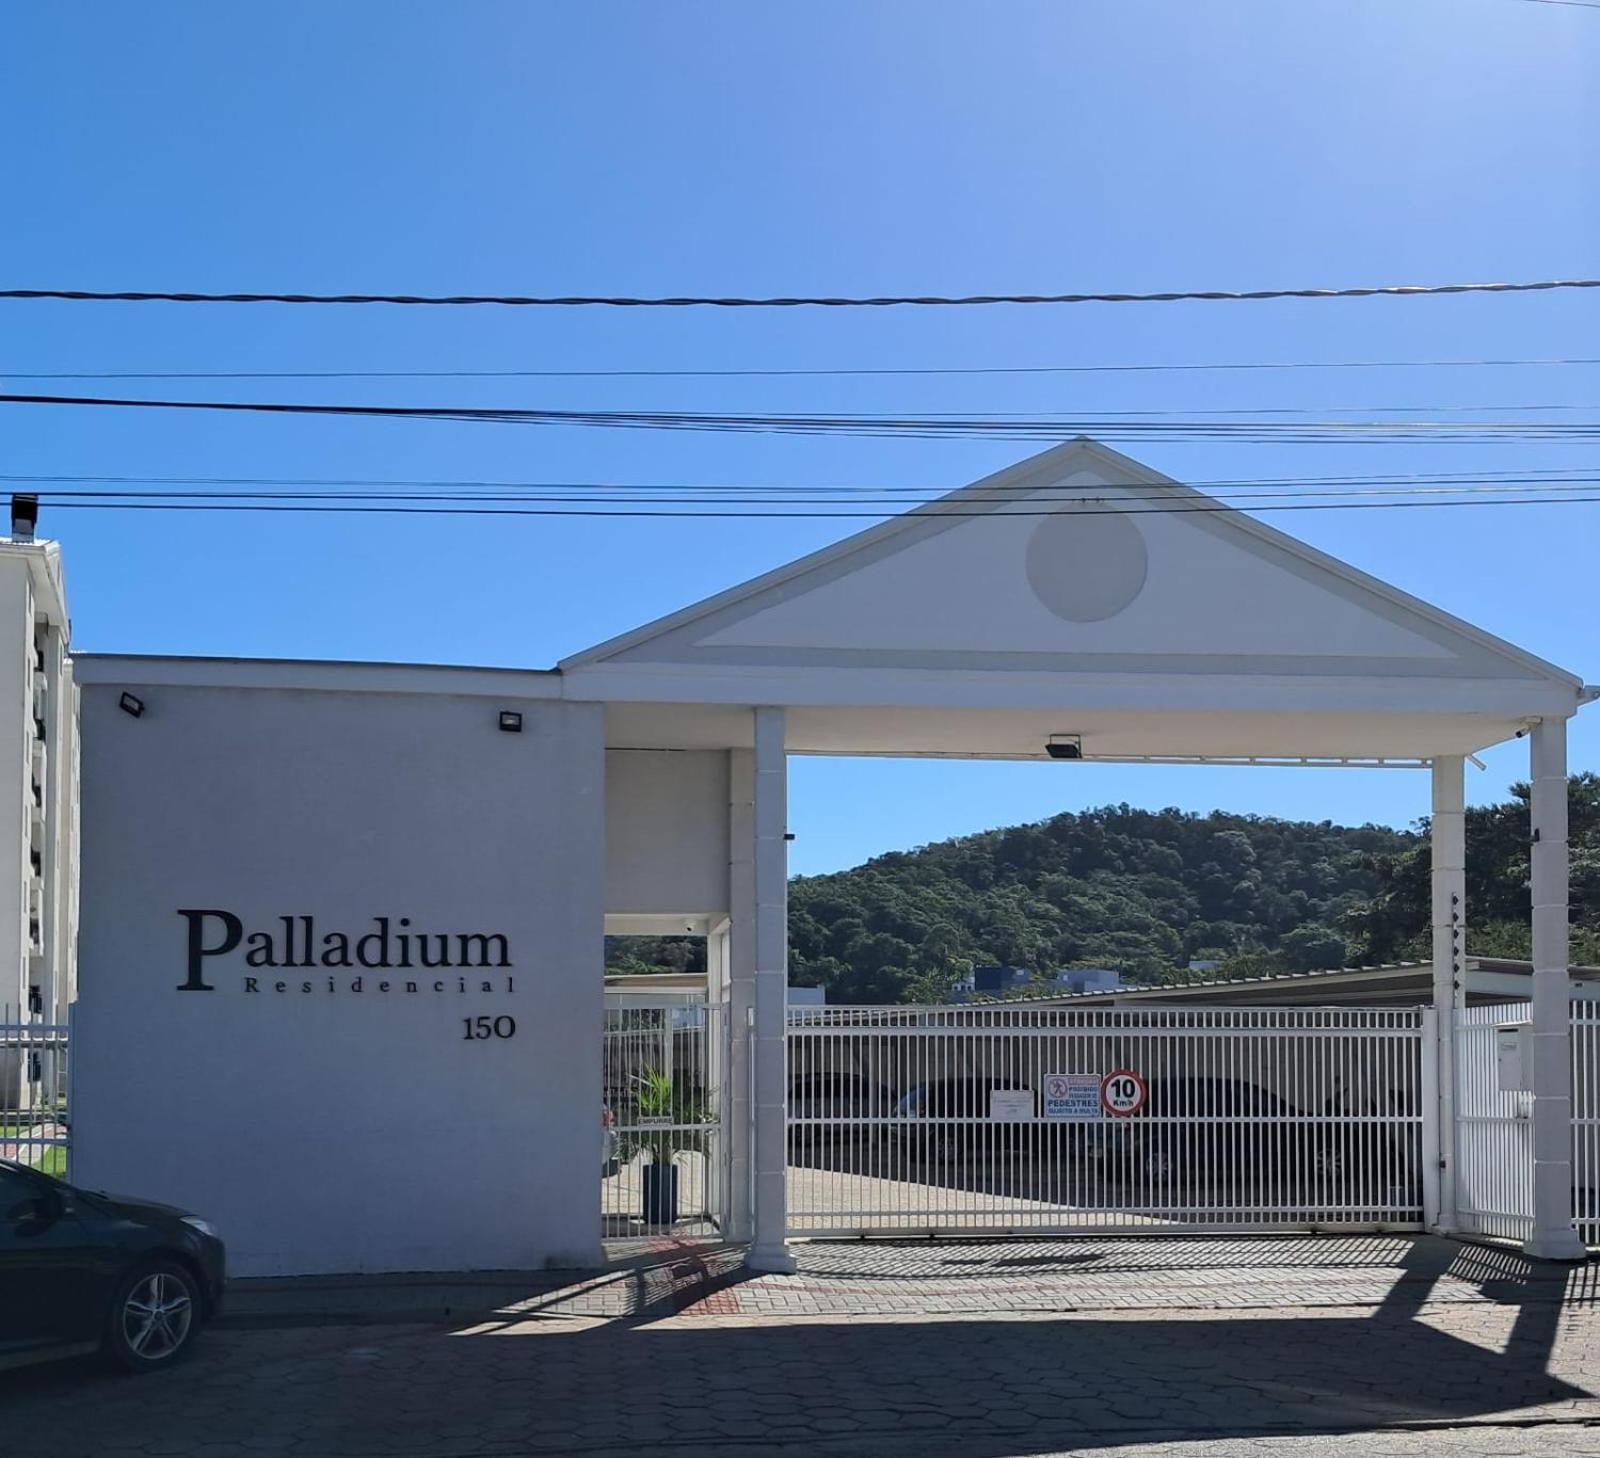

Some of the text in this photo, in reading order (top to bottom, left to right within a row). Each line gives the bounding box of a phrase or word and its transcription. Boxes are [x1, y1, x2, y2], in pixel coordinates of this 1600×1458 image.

[176, 909, 513, 991] Palladium
[244, 976, 515, 992] Residencial
[462, 1015, 516, 1040] 150
[1111, 1079, 1136, 1098] 10
[1047, 1099, 1098, 1107] PEDESTRES
